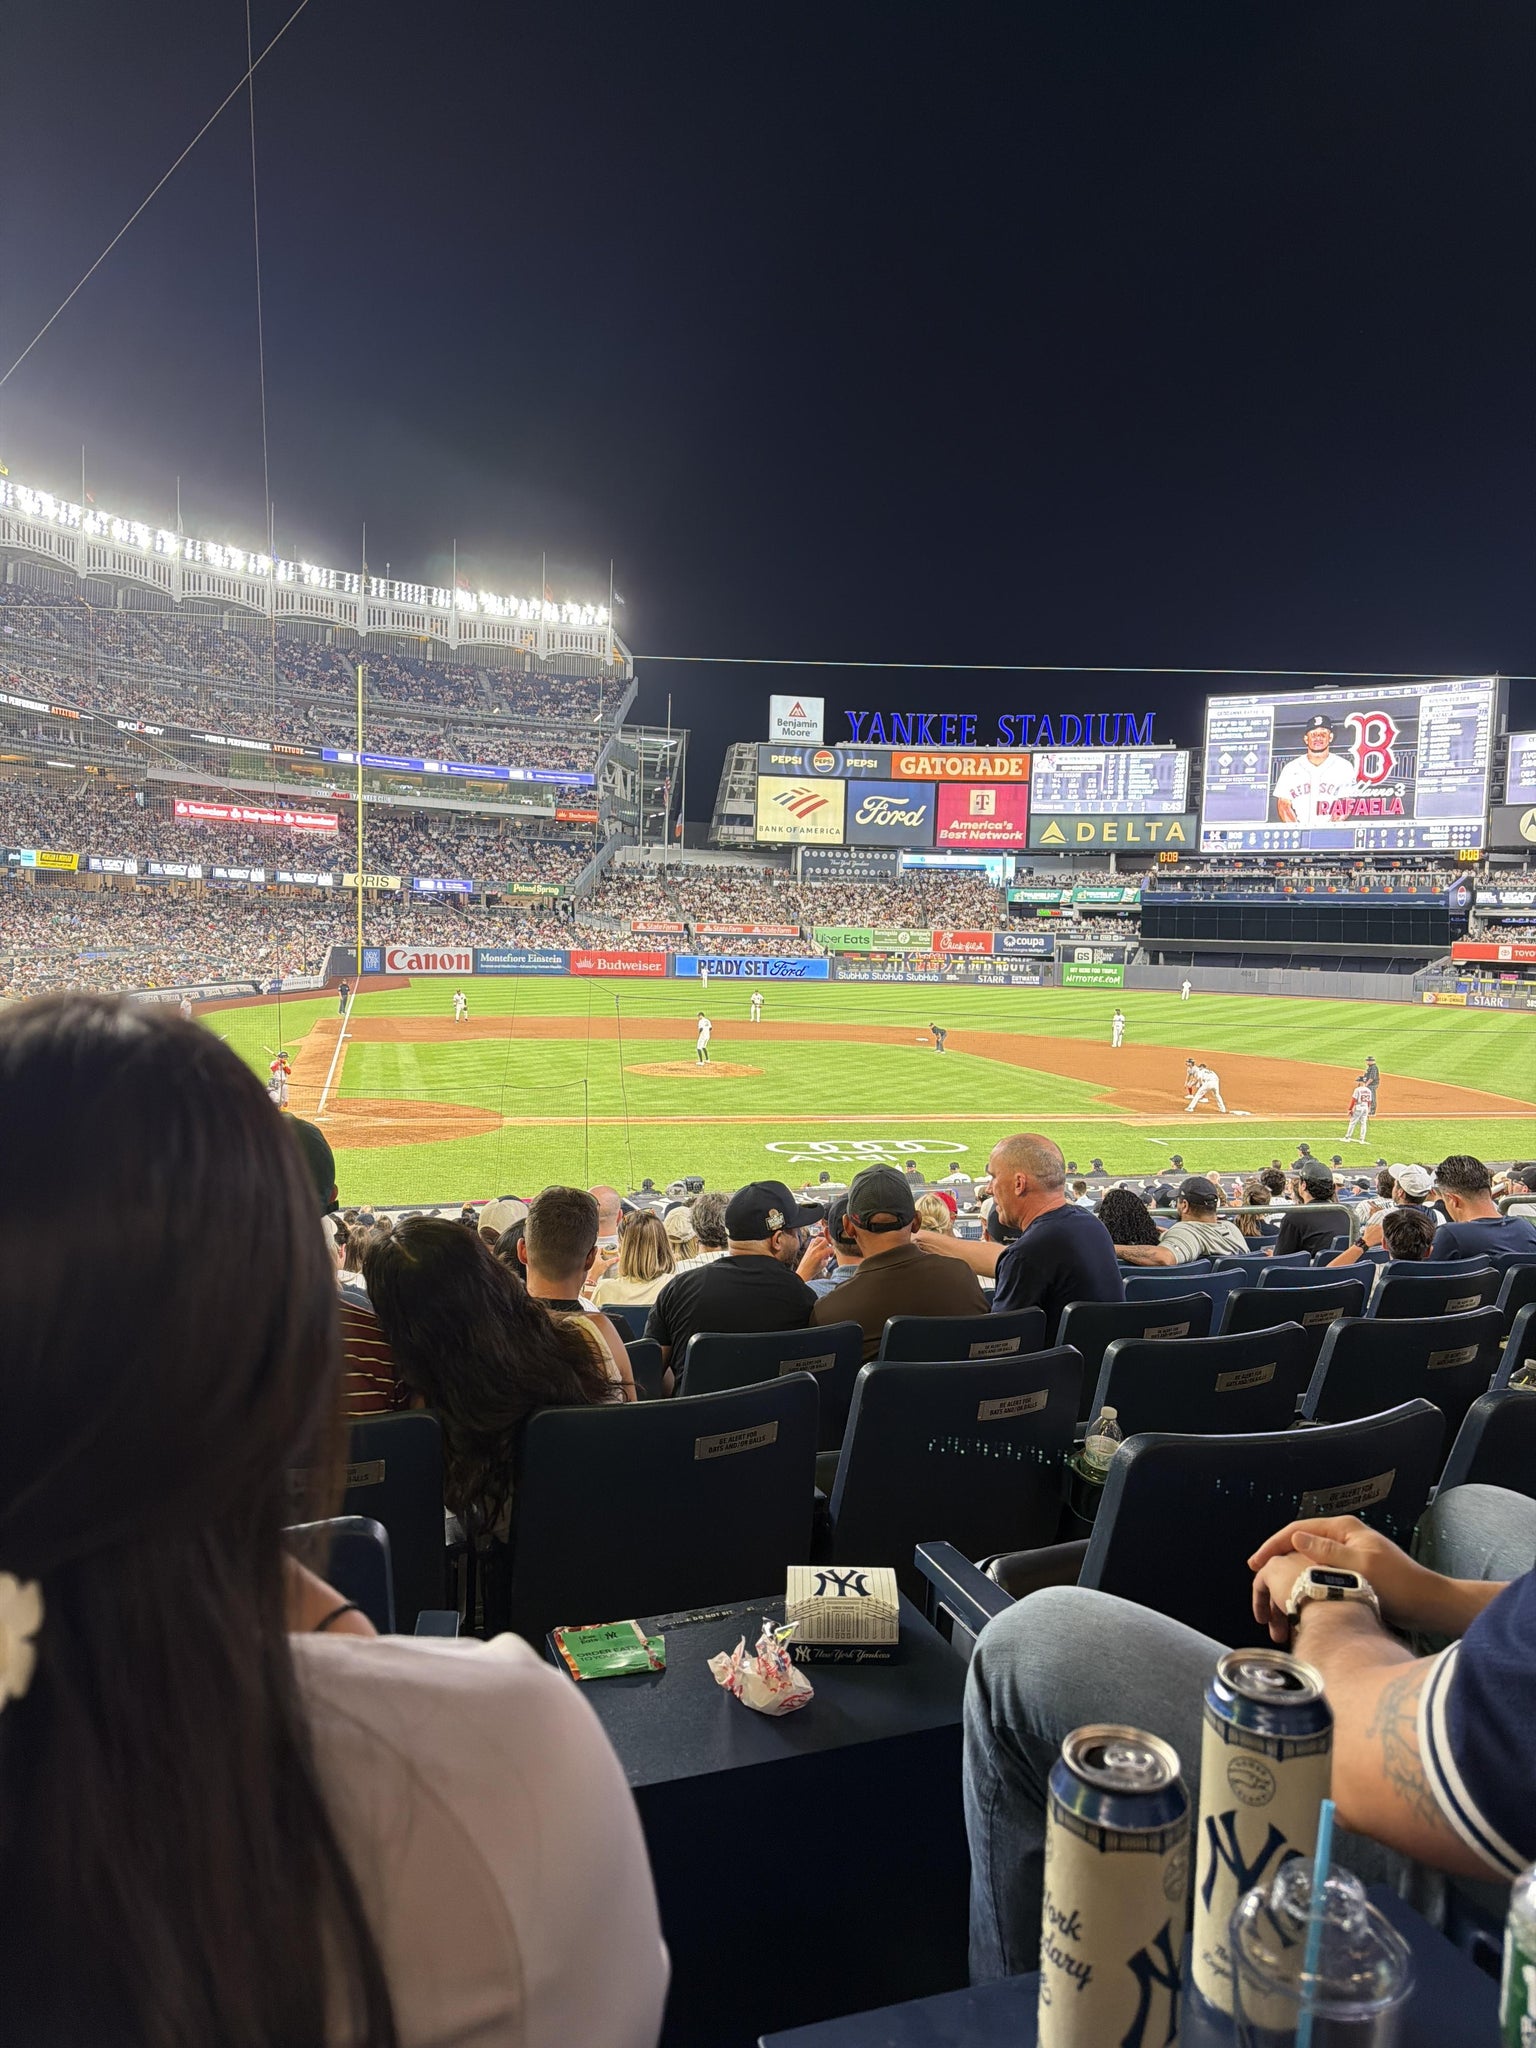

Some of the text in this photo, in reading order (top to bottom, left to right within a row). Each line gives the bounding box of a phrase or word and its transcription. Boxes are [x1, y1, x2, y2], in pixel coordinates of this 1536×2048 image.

[117, 721, 137, 731] BAD
[777, 718, 818, 729] Benjamin
[782, 727, 811, 737] Moore
[844, 711, 1156, 748] YANKEE STADIUM
[1344, 711, 1400, 785] B
[771, 755, 802, 765] PEPSI
[814, 757, 834, 765] PEPSI
[846, 759, 878, 768] PEPSI
[900, 756, 1023, 776] GATORADE
[331, 791, 350, 799] Audi
[1394, 783, 1405, 797] 3
[855, 795, 927, 827] Ford
[1316, 797, 1404, 816] RAFAELA
[759, 825, 841, 835] BANK OF AMERICA
[950, 820, 1013, 830] America's
[940, 830, 1024, 840] Best Network
[1076, 822, 1185, 842] DELTA
[1160, 852, 1179, 863] 0:08
[1460, 850, 1480, 860] 0:08
[353, 876, 389, 887] ORIS
[513, 883, 559, 895] Poland Spring
[844, 934, 870, 944] Eats
[1017, 937, 1045, 948] coupa
[387, 949, 470, 970] Canon
[480, 953, 562, 963] Montefiore Einstein
[1077, 952, 1089, 960] GS
[697, 959, 808, 977] READY SET Ford
[838, 972, 869, 980] StubHub
[906, 973, 938, 981] StubHub
[978, 975, 1004, 984] STARR
[1473, 996, 1504, 1007] STARR
[787, 1154, 900, 1163] Audi
[813, 1569, 872, 1597] NY
[813, 1648, 832, 1658] New
[834, 1649, 854, 1661] York
[856, 1649, 890, 1662] Yankees
